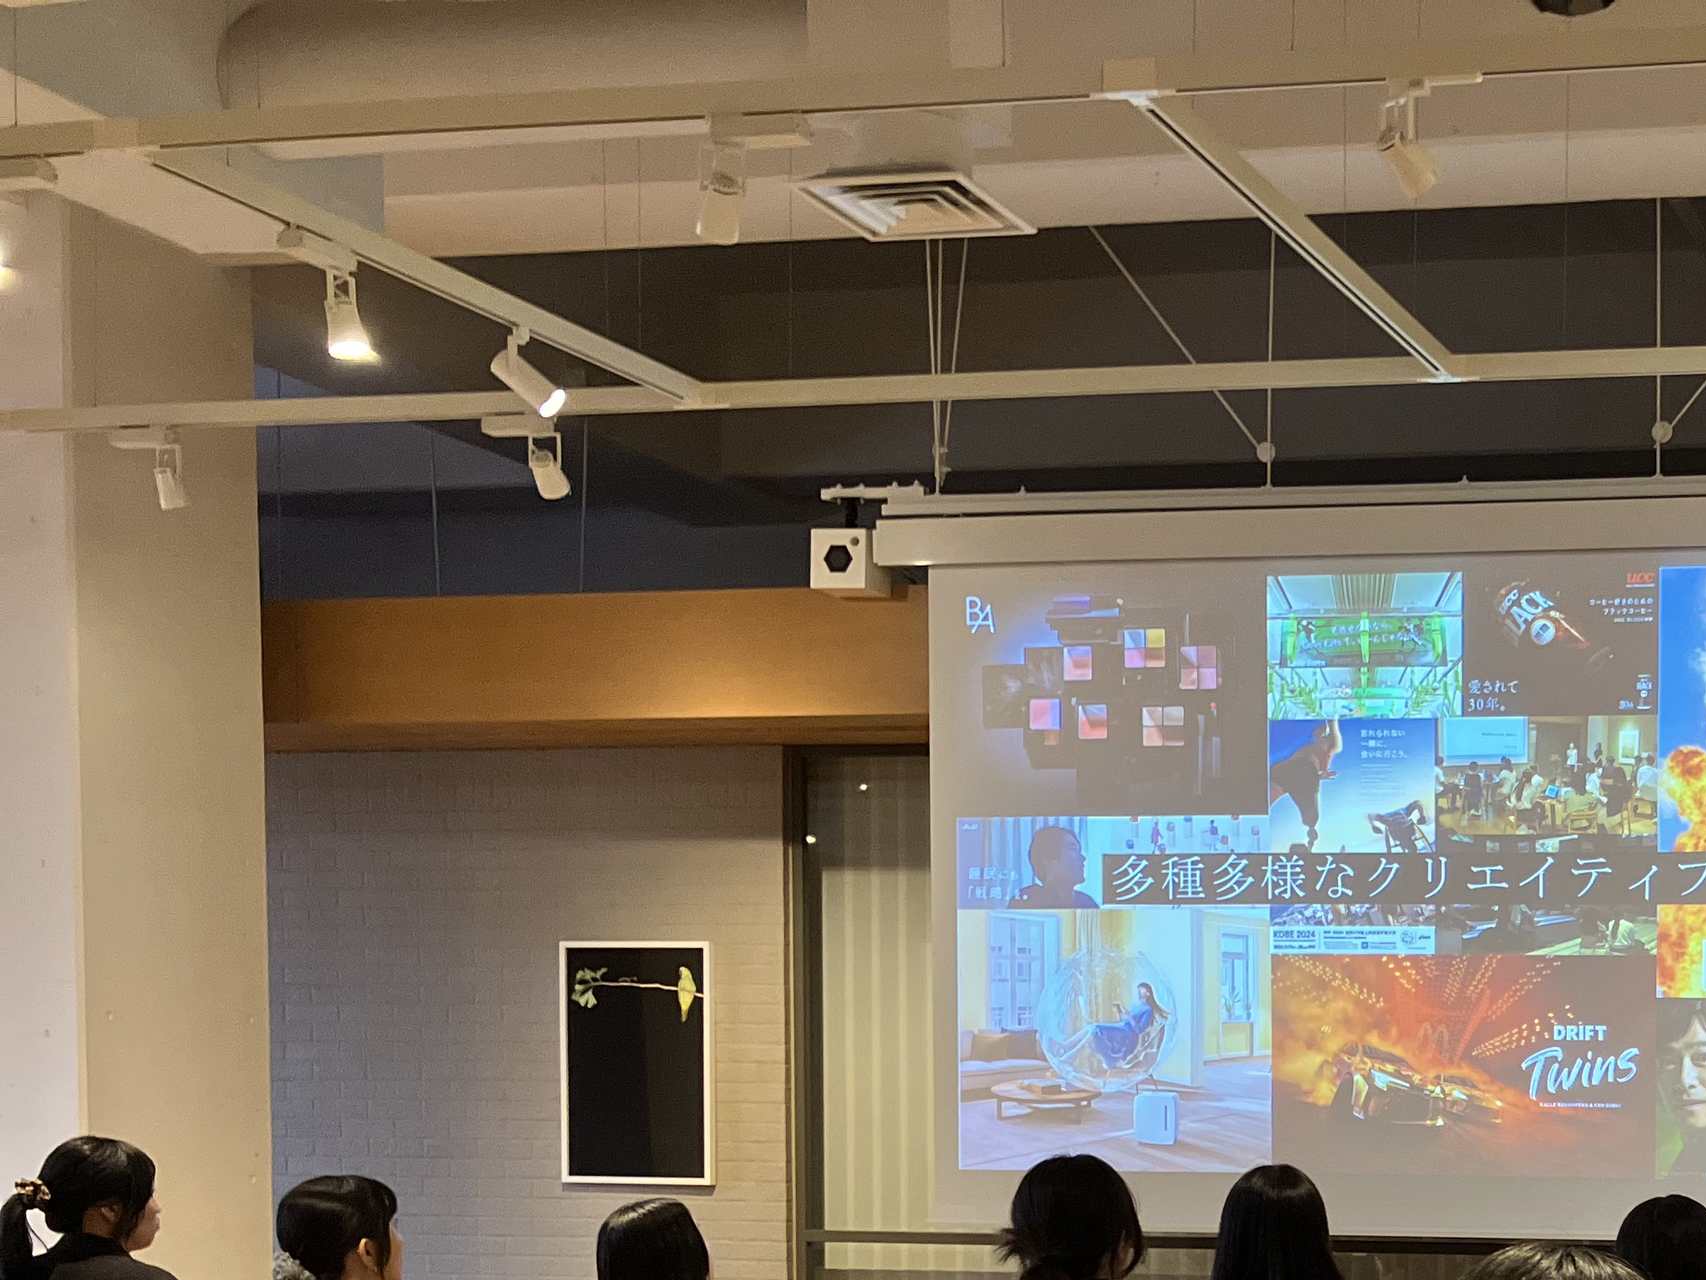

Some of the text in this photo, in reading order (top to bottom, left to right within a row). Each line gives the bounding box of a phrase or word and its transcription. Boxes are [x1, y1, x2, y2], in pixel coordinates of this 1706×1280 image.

[1468, 679, 1518, 694] 愛されて
[1467, 698, 1506, 712] 30年。
[1273, 930, 1295, 939] KOBE
[1296, 930, 1316, 939] 2024
[1553, 1025, 1607, 1041] DRIFT
[1521, 1046, 1640, 1100] Twins
